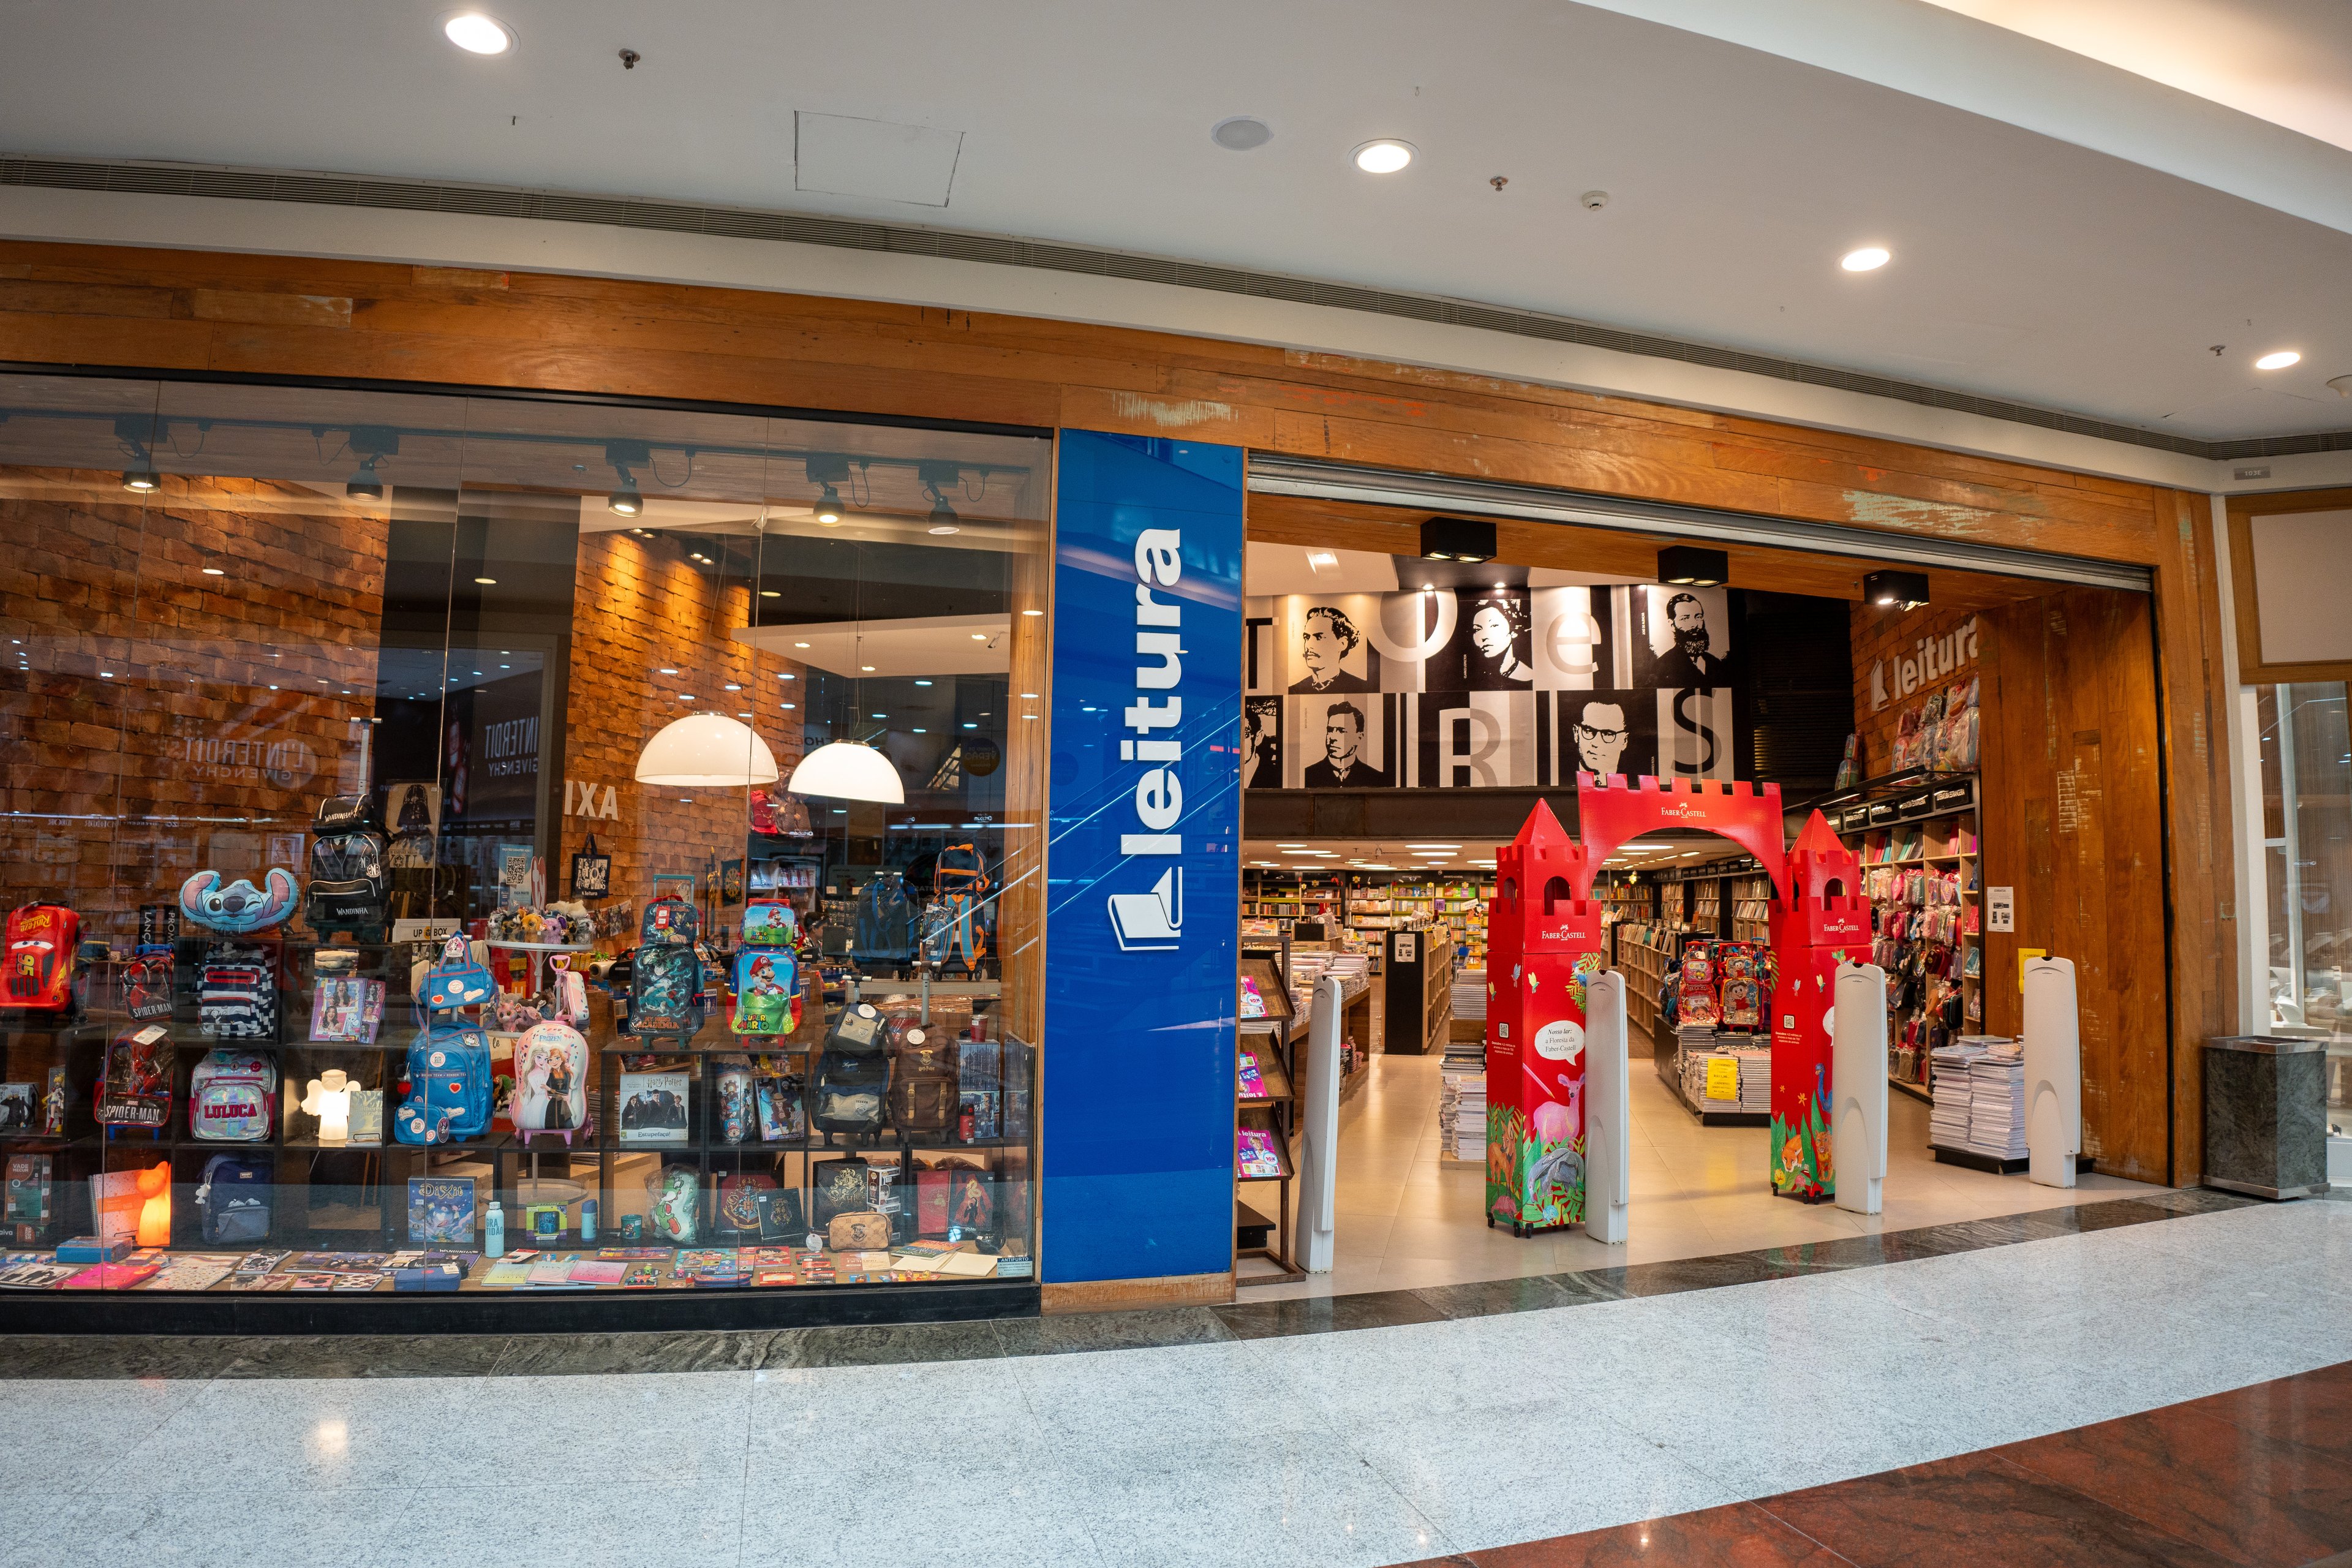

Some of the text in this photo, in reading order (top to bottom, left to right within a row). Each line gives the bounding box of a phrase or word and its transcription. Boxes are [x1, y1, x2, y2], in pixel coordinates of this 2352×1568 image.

[1894, 617, 1978, 699] leitura
[1120, 529, 1182, 855] leitura
[1661, 807, 1706, 817] FABER-CASTELL
[336, 907, 369, 916] WANDINHA
[413, 927, 448, 938] UP BOX
[1823, 923, 1860, 932] FABER-CASTELL
[1542, 930, 1586, 939] FABER-CASTELL
[17, 953, 35, 977] 95
[133, 1002, 172, 1017] SPIDER-MAN
[737, 1020, 770, 1030] MARIO
[647, 1076, 682, 1088] Harry Potter
[105, 1105, 160, 1121] SPIDER-MAN
[204, 1103, 257, 1118] LULUCA
[486, 1218, 498, 1227] GRA
[486, 1226, 503, 1235] TIDÃO
